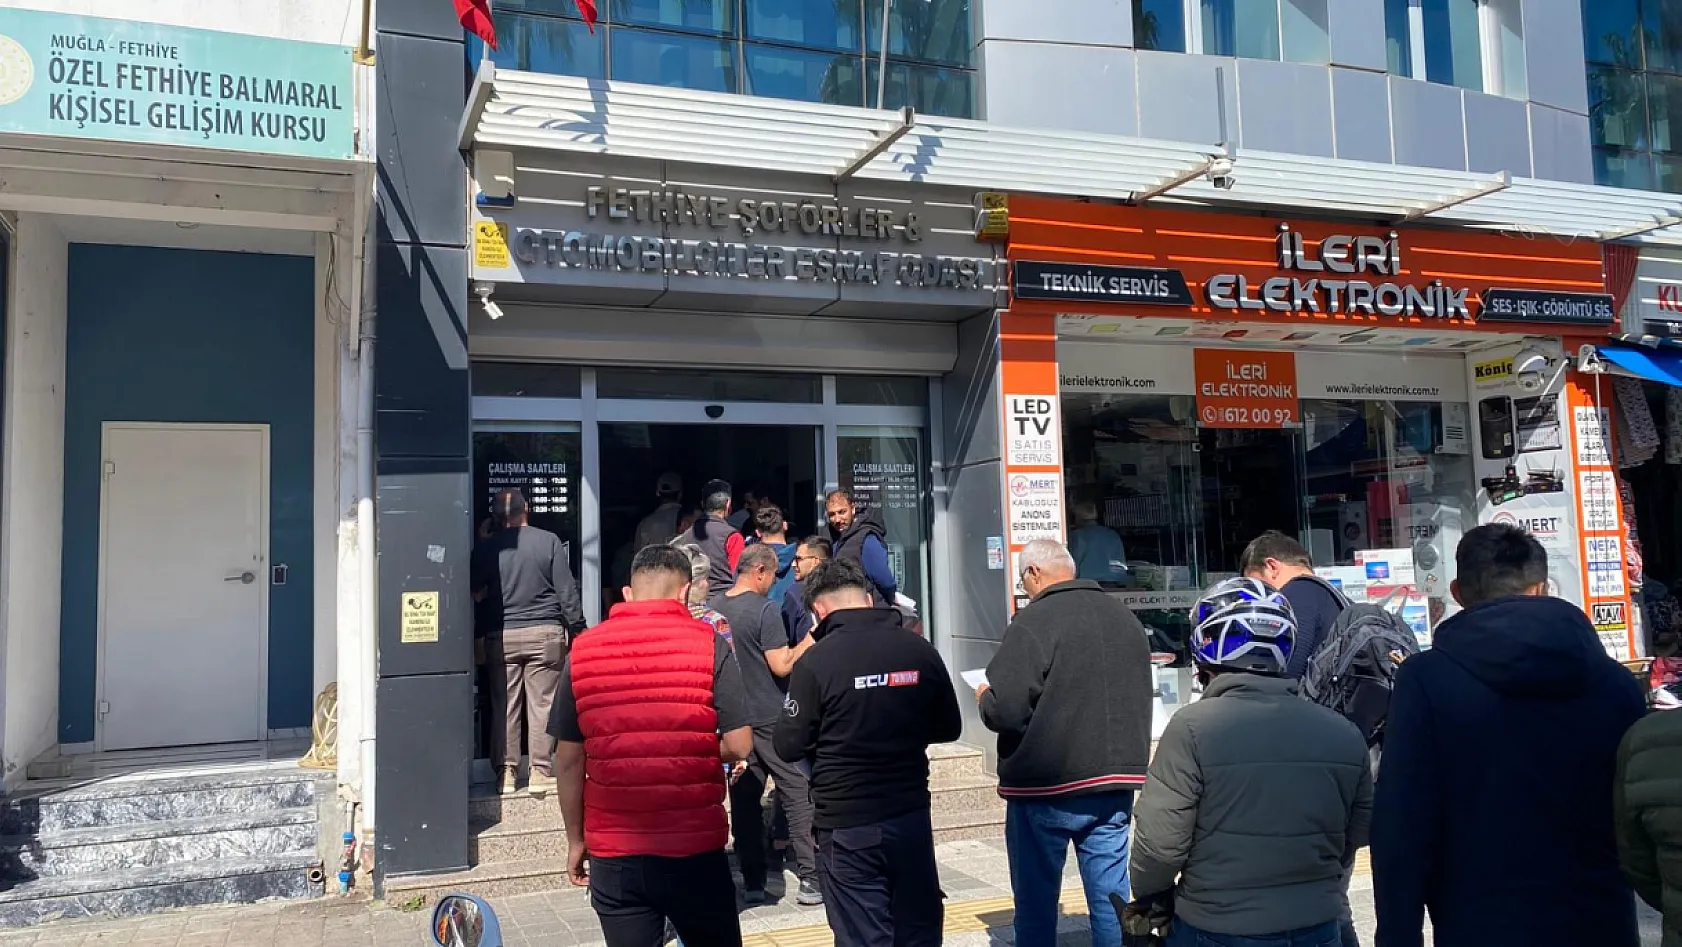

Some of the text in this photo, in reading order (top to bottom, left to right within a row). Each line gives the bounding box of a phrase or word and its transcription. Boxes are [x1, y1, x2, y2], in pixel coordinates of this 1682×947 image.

[51, 34, 105, 52] MUĞLA
[119, 41, 178, 60] FETHİYE
[49, 52, 342, 110] ÖZEL FETHİYE BALMARAL
[50, 90, 326, 142] KİŞİSEL GELİŞİM KURSU
[587, 185, 923, 241] FETHİYE ŞOFÖRLER &
[1276, 222, 1401, 276] İLERİ
[796, 247, 899, 286] ESNAF
[900, 252, 985, 290] ODASI
[1040, 270, 1169, 297] TEKNİK SERVİS
[1206, 274, 1470, 320] ELEKTRONİK
[1226, 360, 1267, 380] İLERİ
[1060, 375, 1156, 388] ilerielektronik.com
[1325, 383, 1439, 396] www.ilerielektronik.com.tr
[1202, 382, 1293, 399] ELEKTRONİK
[1013, 399, 1051, 414] LED
[1225, 407, 1291, 424] 612 00 92
[1014, 417, 1051, 435] TV
[488, 461, 566, 476] ÇALIŞMA SAATLERİ
[853, 463, 915, 475] ÇALIŞMA SAATLERİ
[1029, 480, 1055, 489] MERT
[1021, 511, 1051, 519] ANONS
[1518, 517, 1557, 534] MERT
[854, 673, 889, 690] ECU
